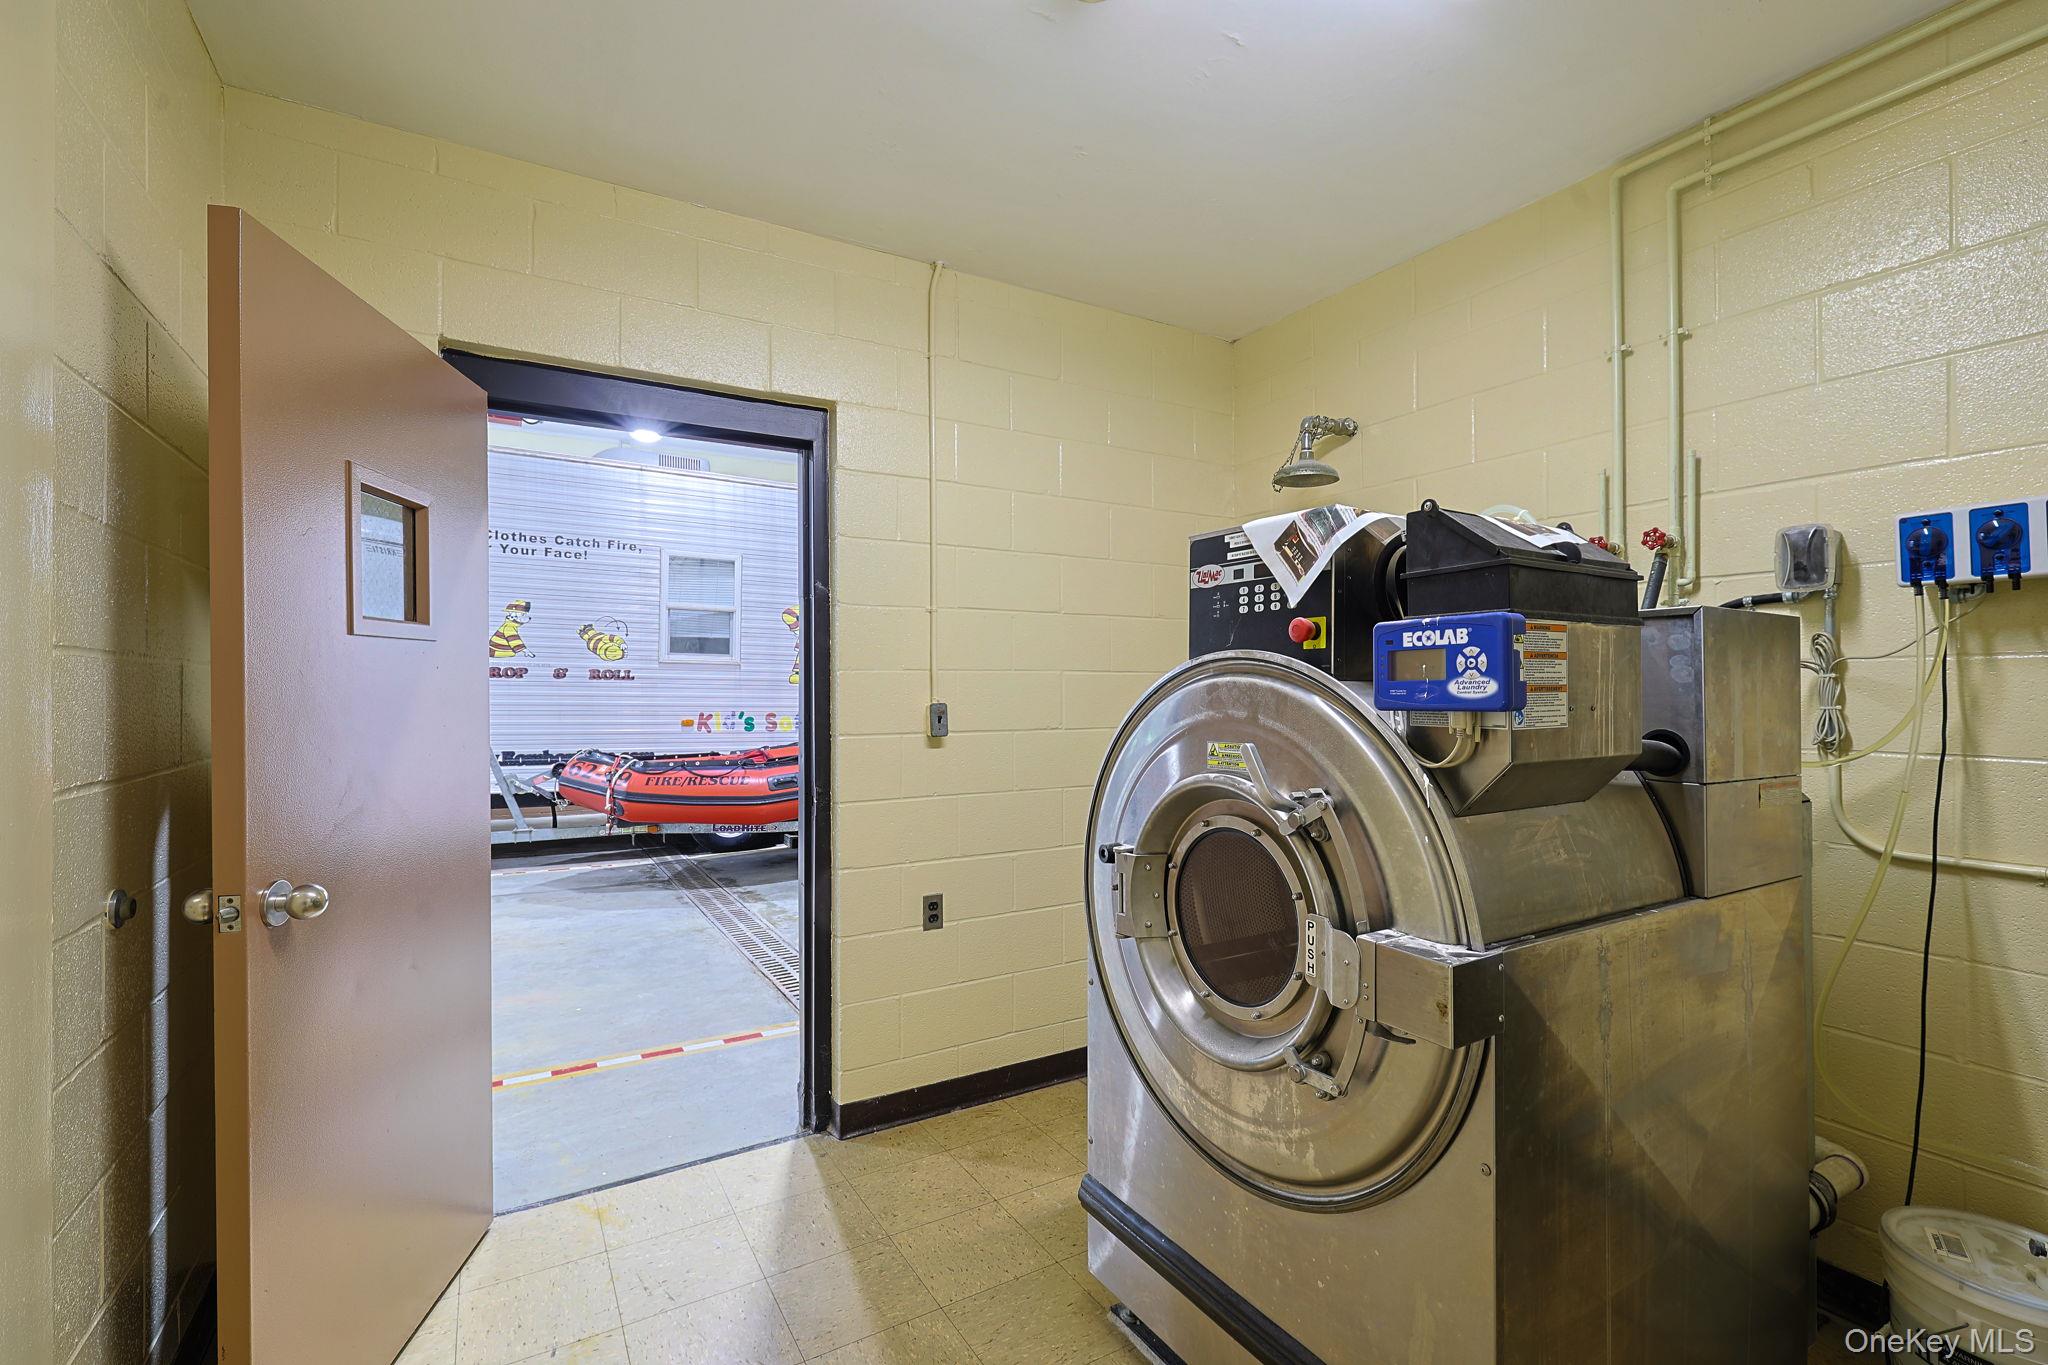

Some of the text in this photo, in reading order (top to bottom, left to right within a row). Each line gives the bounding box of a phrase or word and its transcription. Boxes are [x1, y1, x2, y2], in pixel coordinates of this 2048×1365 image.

[500, 543, 588, 560] Your Face!
[554, 534, 600, 549] Catch
[607, 539, 642, 554] Fire,
[1402, 627, 1469, 647] ECOLAB
[552, 667, 568, 679] &
[588, 668, 635, 681] ROLL
[645, 776, 750, 787] FIRE/RESCUE
[1307, 920, 1315, 974] PUSH
